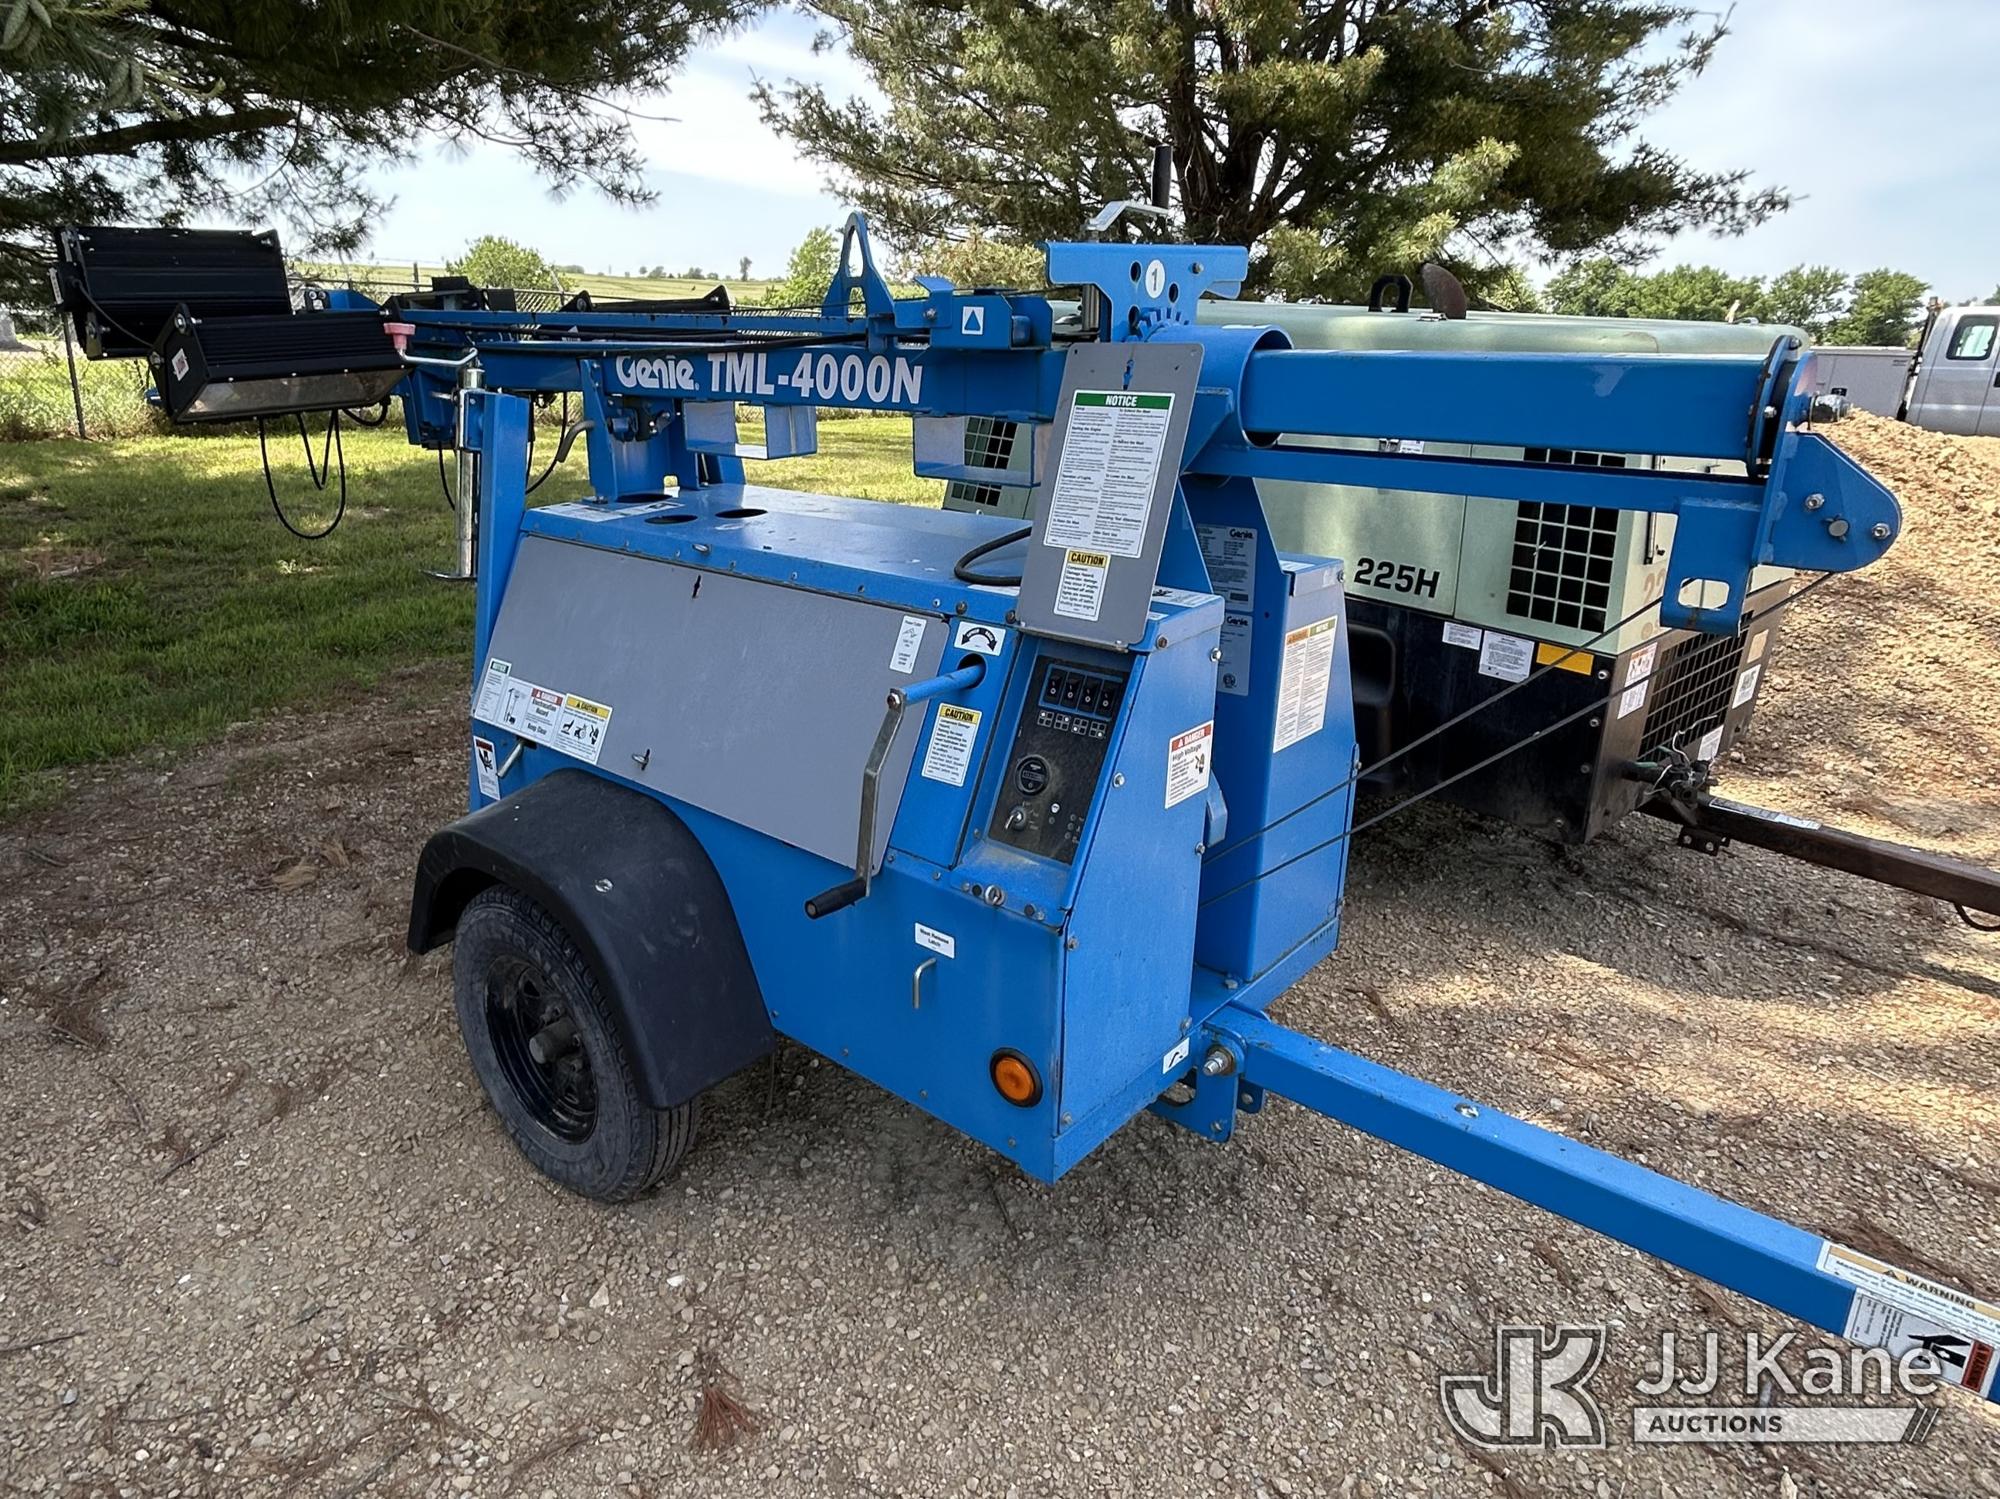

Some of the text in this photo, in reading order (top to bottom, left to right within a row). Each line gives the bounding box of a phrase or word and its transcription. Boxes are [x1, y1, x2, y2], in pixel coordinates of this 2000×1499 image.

[1150, 267, 1159, 291] 1
[616, 352, 923, 405] Genie TML-4000N
[1106, 395, 1138, 406] NOTICE
[1229, 529, 1254, 539] Genie
[1071, 553, 1104, 565] CAUTION
[1354, 558, 1440, 598] 225H
[1227, 616, 1248, 626] Genie
[945, 709, 974, 721] CAUTION
[1905, 1275, 1975, 1310] WARNING
